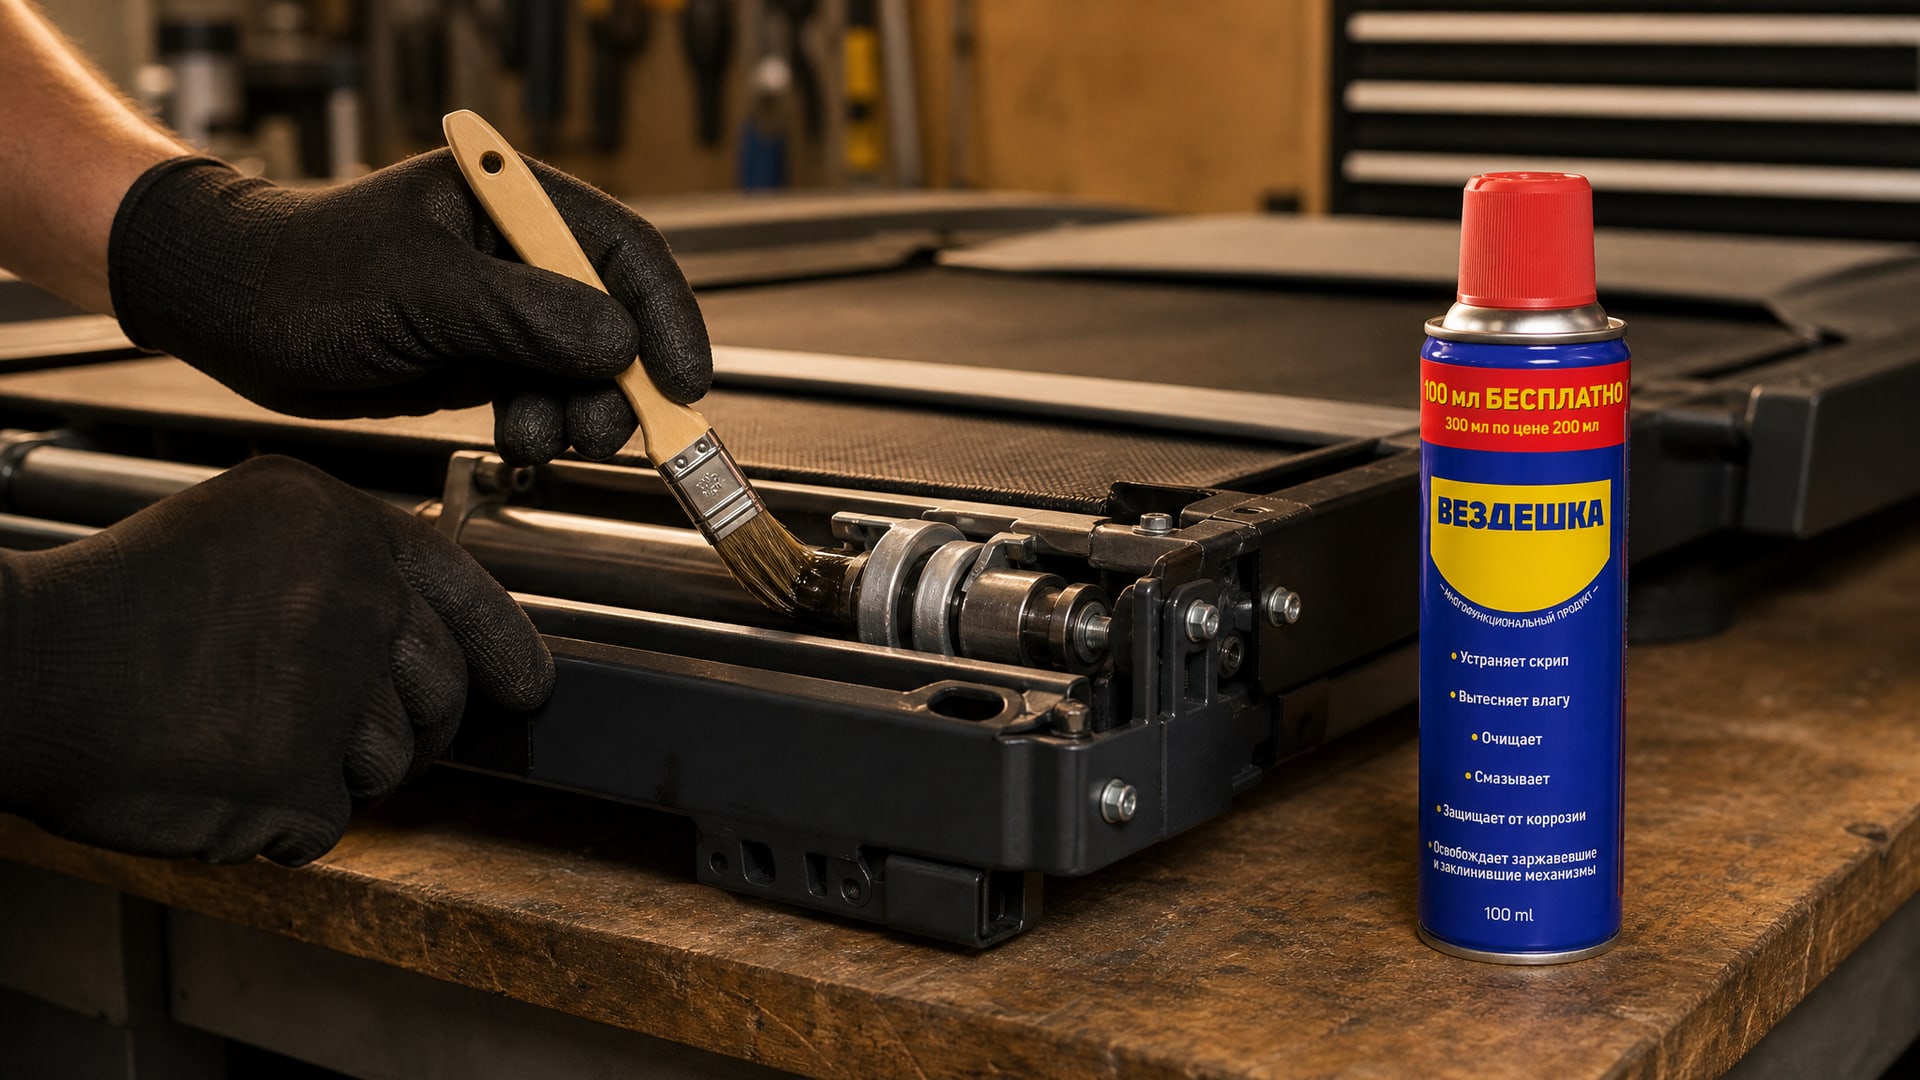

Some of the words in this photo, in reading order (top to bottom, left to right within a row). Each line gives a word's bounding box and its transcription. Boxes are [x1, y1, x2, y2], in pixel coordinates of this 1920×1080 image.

[1424, 379, 1448, 405] 100
[1452, 389, 1480, 409] мл
[1486, 381, 1623, 411] БЕСПЛАТНО
[1445, 416, 1468, 432] 300
[1471, 421, 1489, 434] мл
[1493, 423, 1510, 435] по
[1513, 423, 1549, 437] цене
[1552, 420, 1580, 434] 200
[1582, 420, 1599, 433] мл
[1438, 495, 1604, 531] ВЕЗДЕШКА
[1557, 591, 1593, 620] ПРОДУКТ
[1460, 650, 1526, 668] Устраняет
[1529, 656, 1569, 670] скрип
[1458, 690, 1529, 707] Вытесняет
[1532, 695, 1570, 708] влагу
[1481, 731, 1543, 747] Очищает
[1474, 770, 1550, 785] Смазывает
[1443, 803, 1505, 825] Защищает
[1508, 814, 1523, 825] от
[1526, 811, 1586, 828] коррозии
[1433, 840, 1508, 865] Освобождает
[1511, 848, 1598, 868] заржавевшие
[1433, 859, 1439, 870] и
[1440, 861, 1521, 881] заклинившие
[1525, 865, 1596, 881] механизмы
[1484, 906, 1511, 921] 100
[1514, 907, 1534, 922] ml
